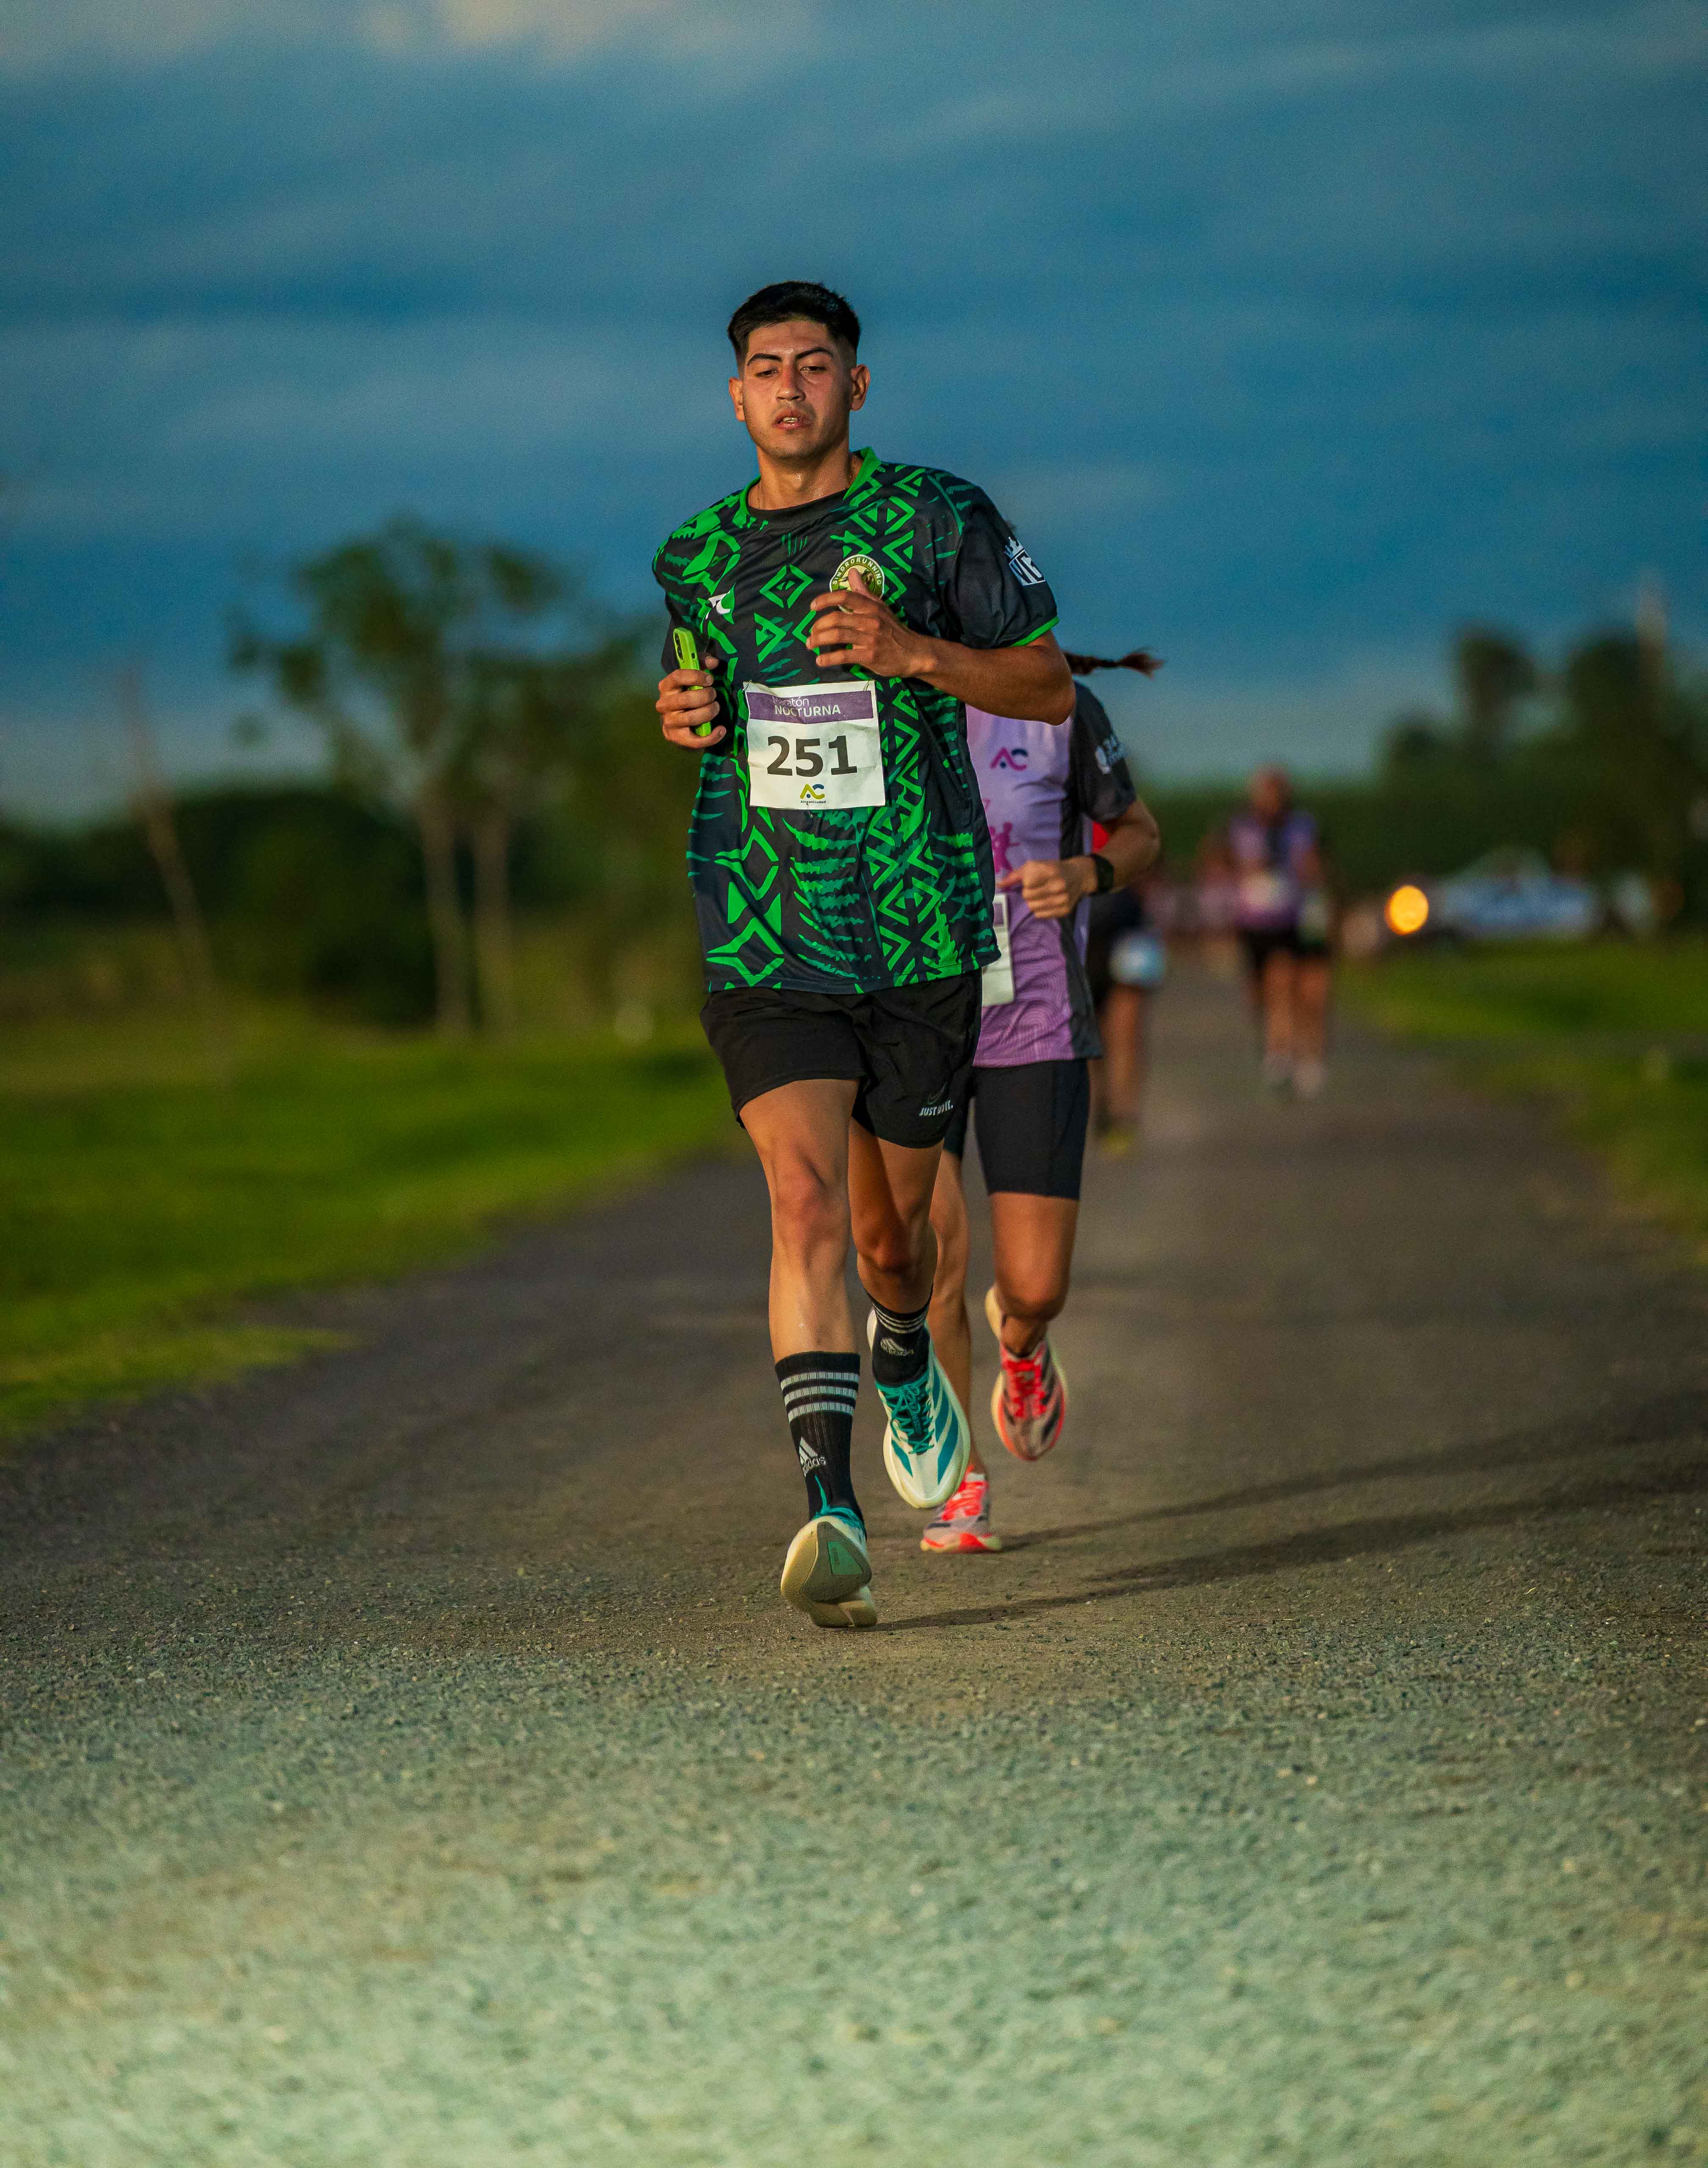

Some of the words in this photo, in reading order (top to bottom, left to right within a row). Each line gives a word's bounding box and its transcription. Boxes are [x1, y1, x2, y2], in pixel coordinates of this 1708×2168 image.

[774, 704, 841, 717] NOCTURNA
[767, 735, 858, 777] 251
[919, 1106, 937, 1116] JUST
